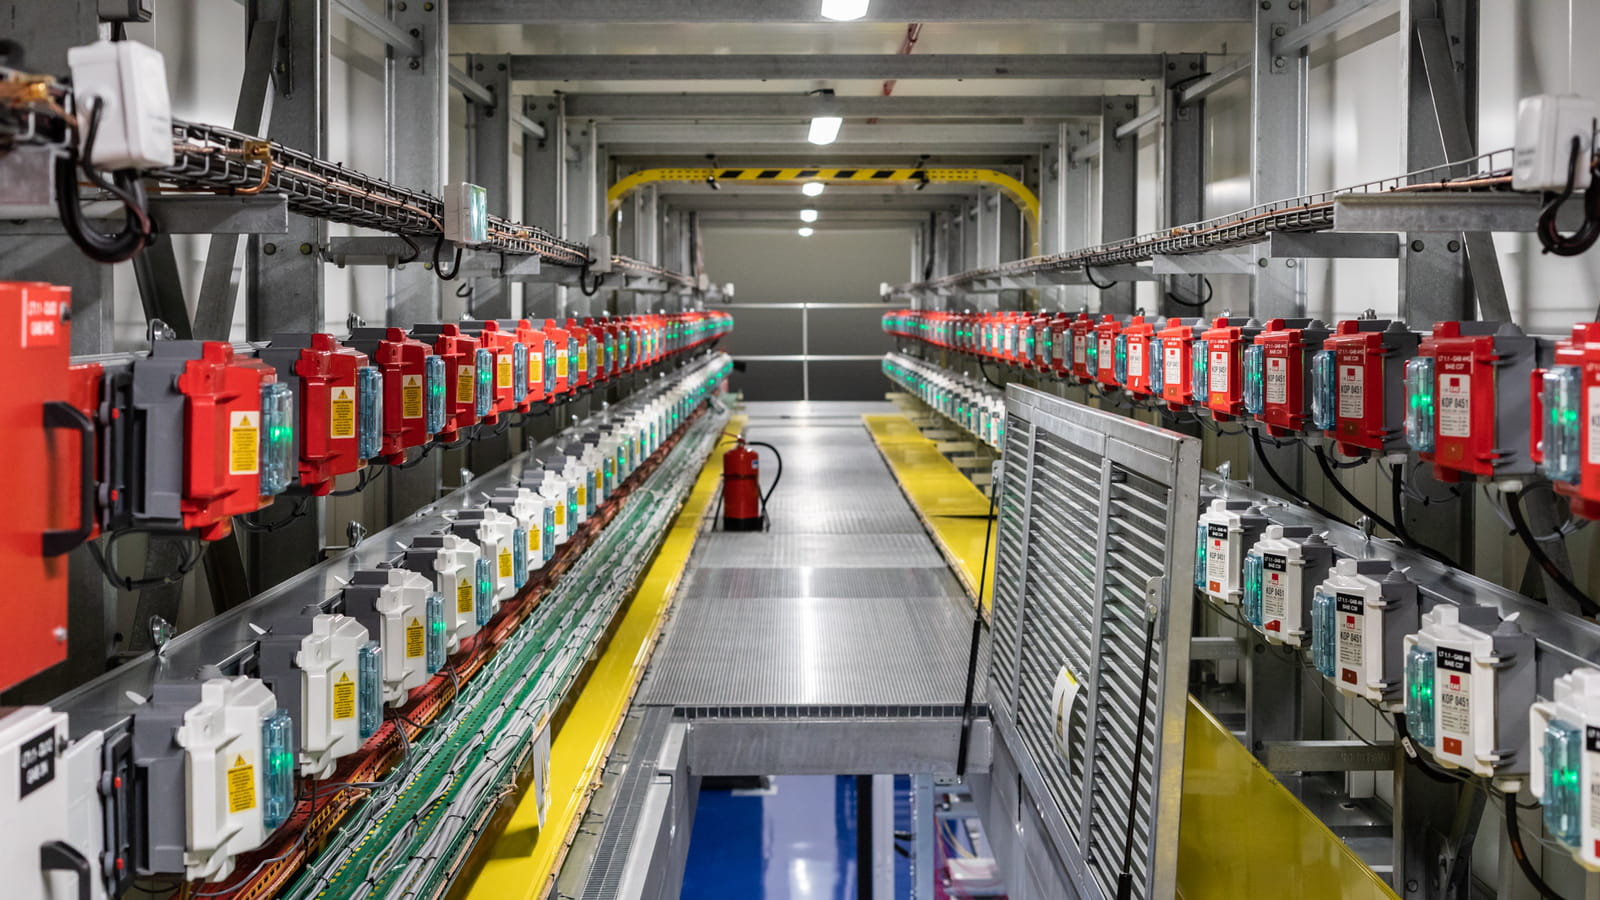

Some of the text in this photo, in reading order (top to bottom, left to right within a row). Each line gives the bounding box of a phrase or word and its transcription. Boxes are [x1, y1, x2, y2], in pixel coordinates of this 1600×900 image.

[1454, 398, 1468, 408] 0451
[1350, 632, 1362, 643] 0451
[1455, 695, 1469, 708] 0451
